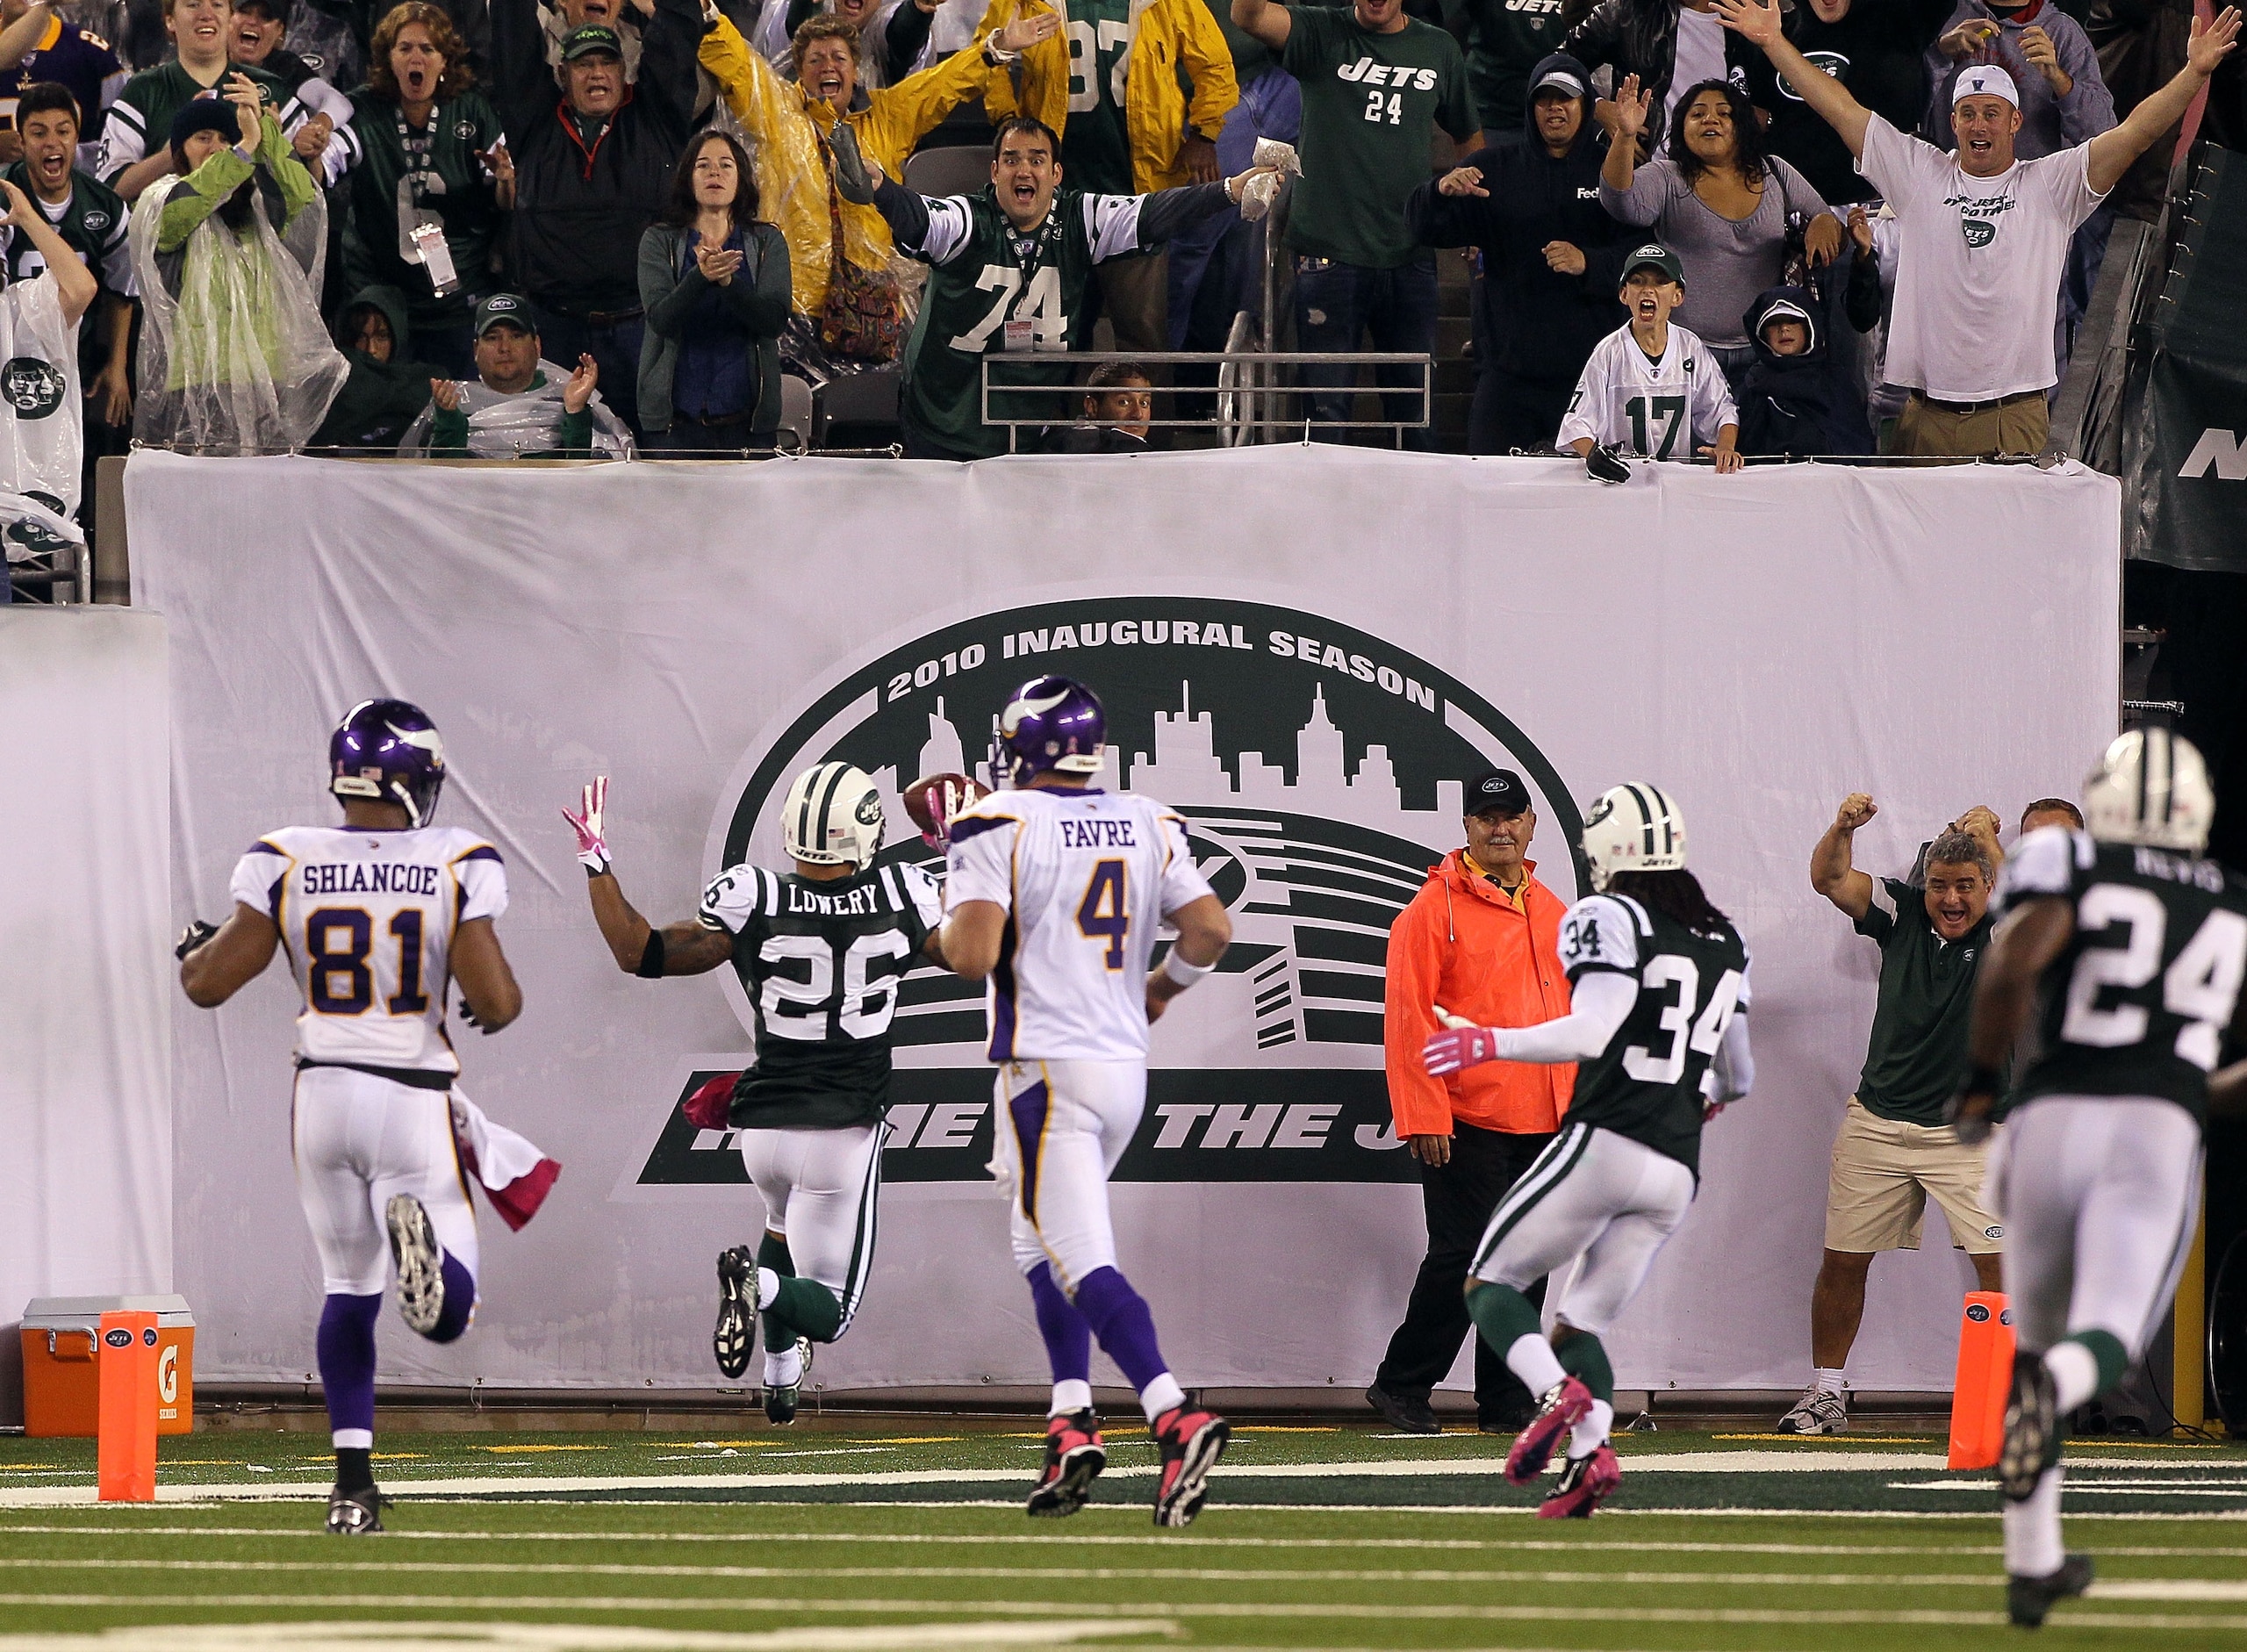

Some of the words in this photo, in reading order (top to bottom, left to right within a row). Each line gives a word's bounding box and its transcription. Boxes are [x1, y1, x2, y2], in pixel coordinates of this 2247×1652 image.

[1337, 57, 1438, 91] JETS
[1364, 90, 1402, 125] 24
[1963, 226, 1990, 238] ETS
[948, 263, 1068, 353] 74
[1625, 395, 1686, 462] 17
[887, 643, 986, 703] 2010
[1002, 620, 1253, 659] INAUGURAL
[1268, 630, 1435, 714] SEASON
[1060, 820, 1136, 847] FAVRE
[305, 864, 439, 896] SHIANCOE
[788, 883, 879, 916] LOWERY
[1074, 857, 1131, 973] 4
[1566, 919, 1602, 959] 34
[305, 905, 432, 1017] 81
[757, 928, 912, 1041] 26
[2061, 882, 2247, 1073] 24
[1622, 953, 1742, 1092] 34
[1152, 1103, 1344, 1149] THE
[158, 1345, 178, 1404] G
